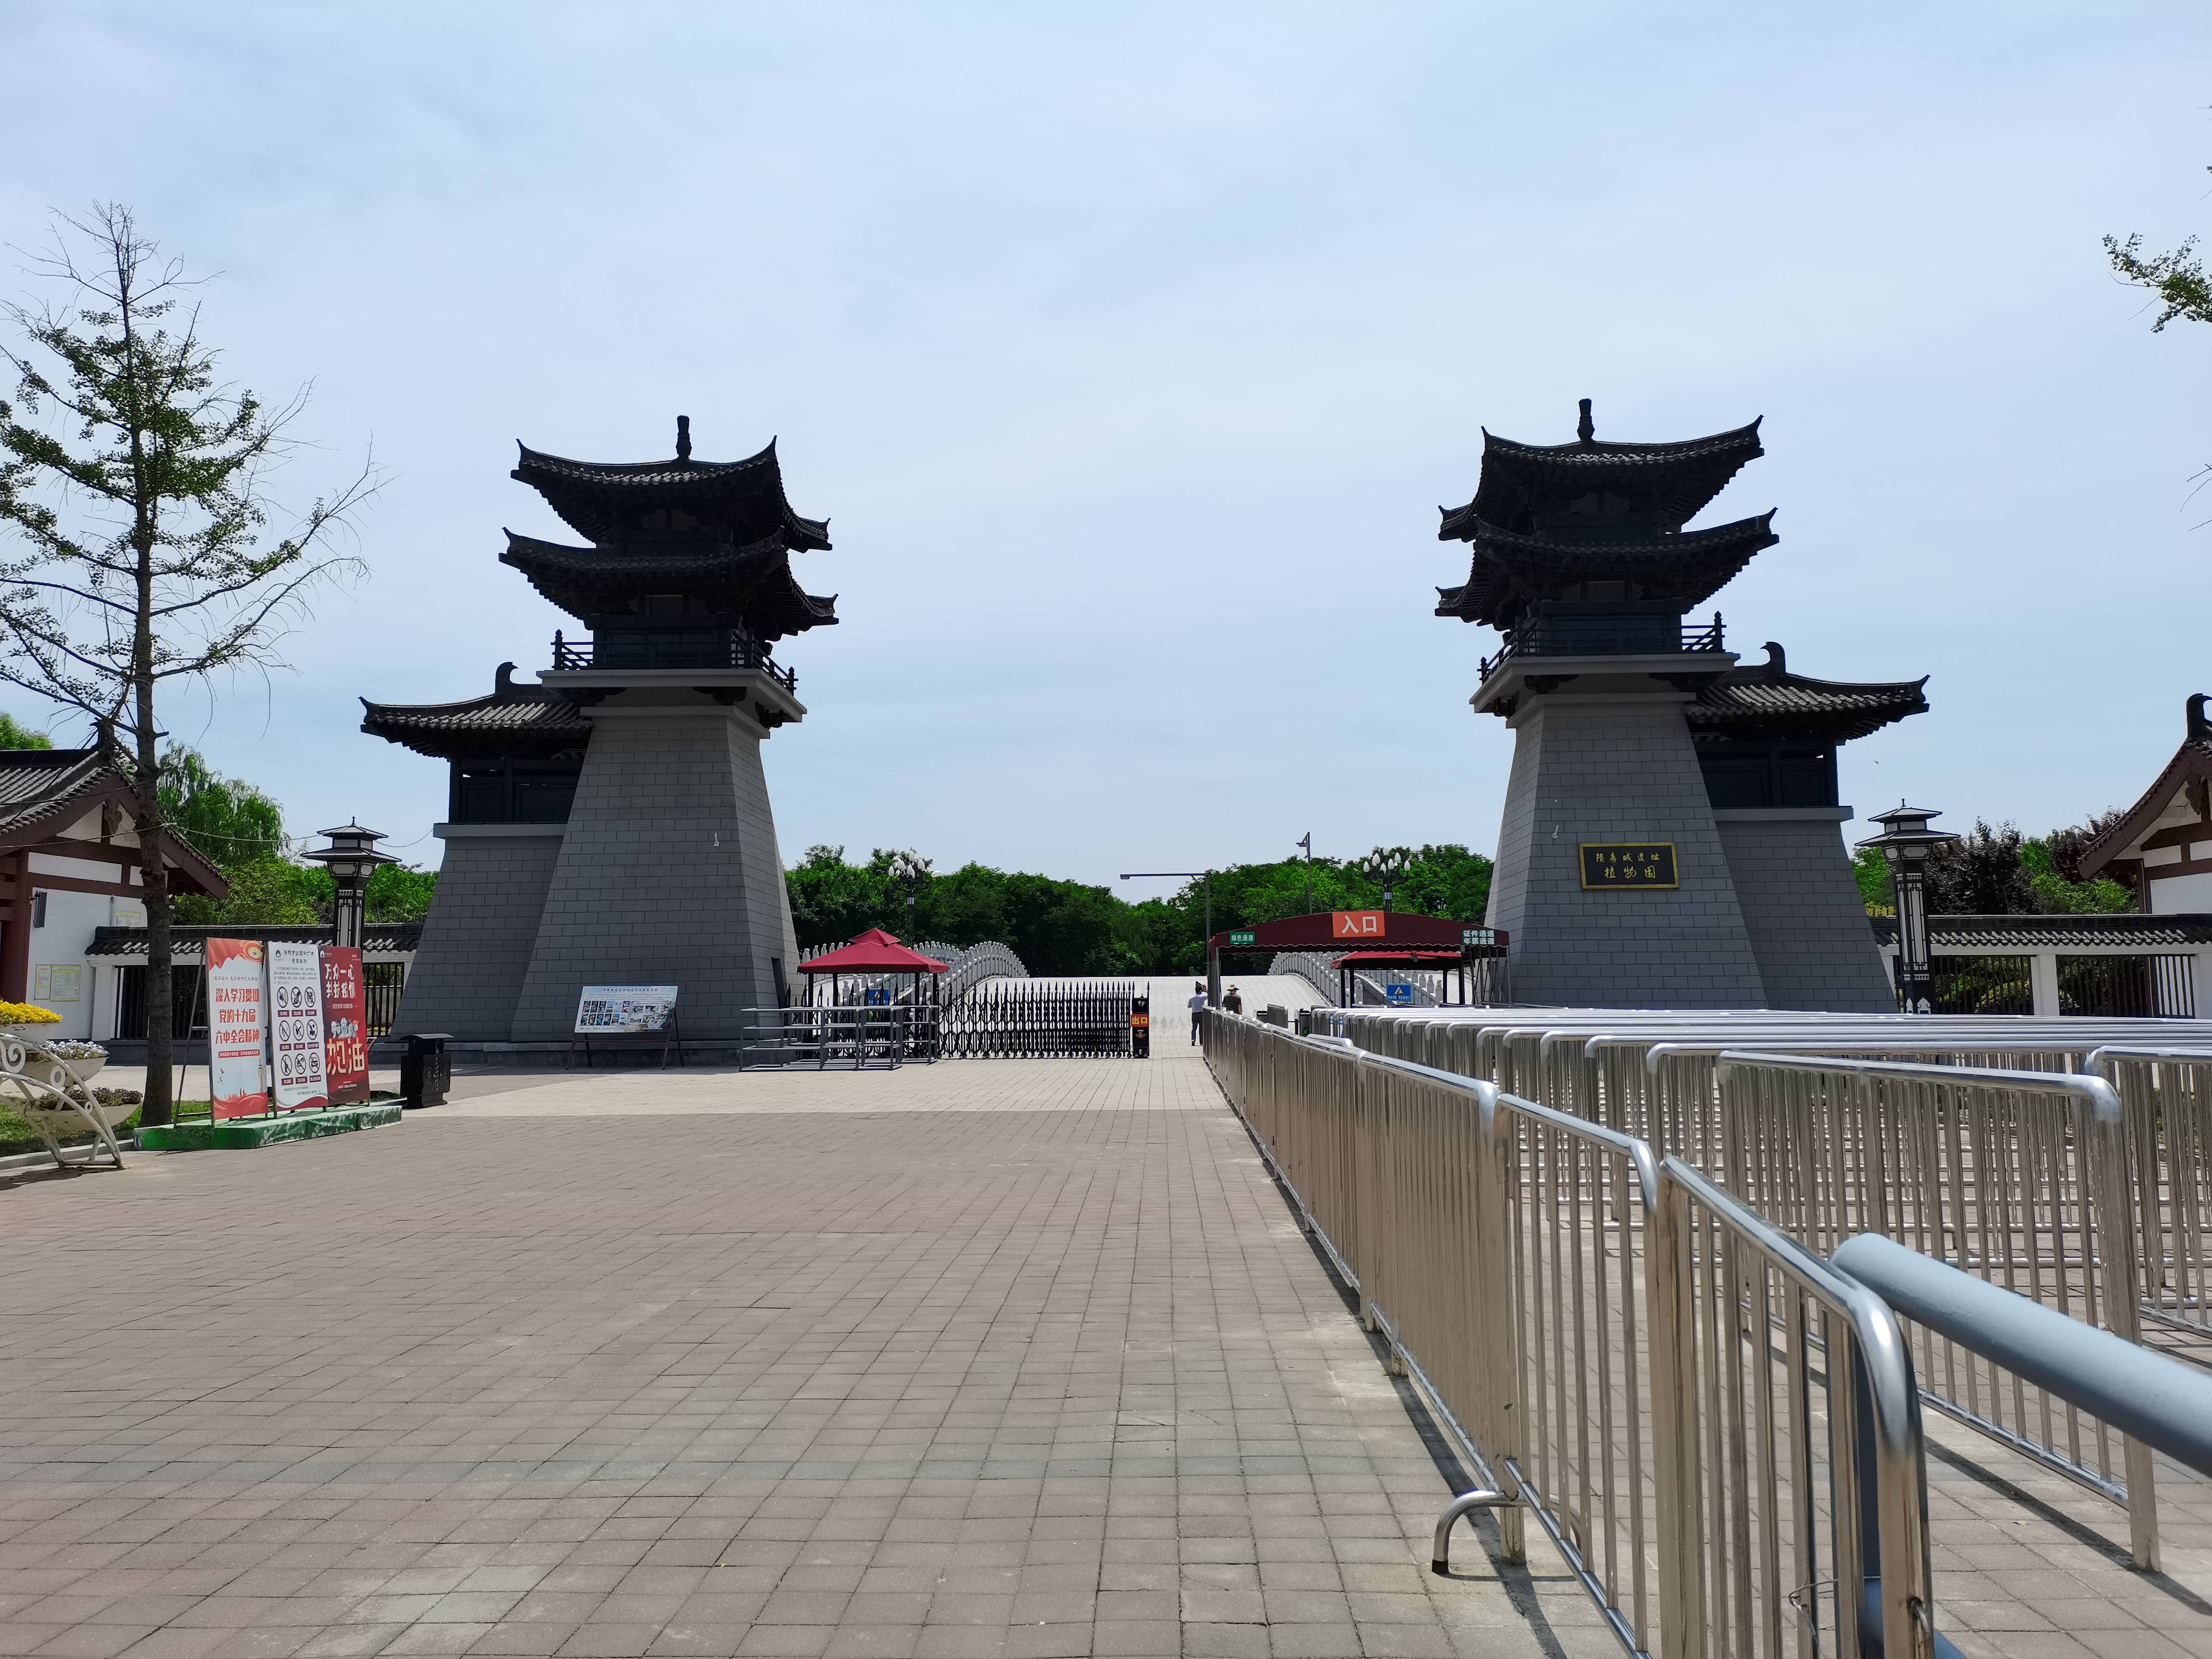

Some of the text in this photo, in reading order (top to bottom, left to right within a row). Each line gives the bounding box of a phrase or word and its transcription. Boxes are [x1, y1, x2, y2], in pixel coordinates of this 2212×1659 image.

[1341, 914, 1378, 934] 入口
[325, 963, 355, 980] 万众一心
[216, 988, 260, 1002] 深入学习贯彻
[219, 1009, 256, 1023] 党的十九届
[1131, 1016, 1148, 1024] 出口
[215, 1028, 260, 1044] 六中全会精神
[326, 1036, 365, 1075] 加油
